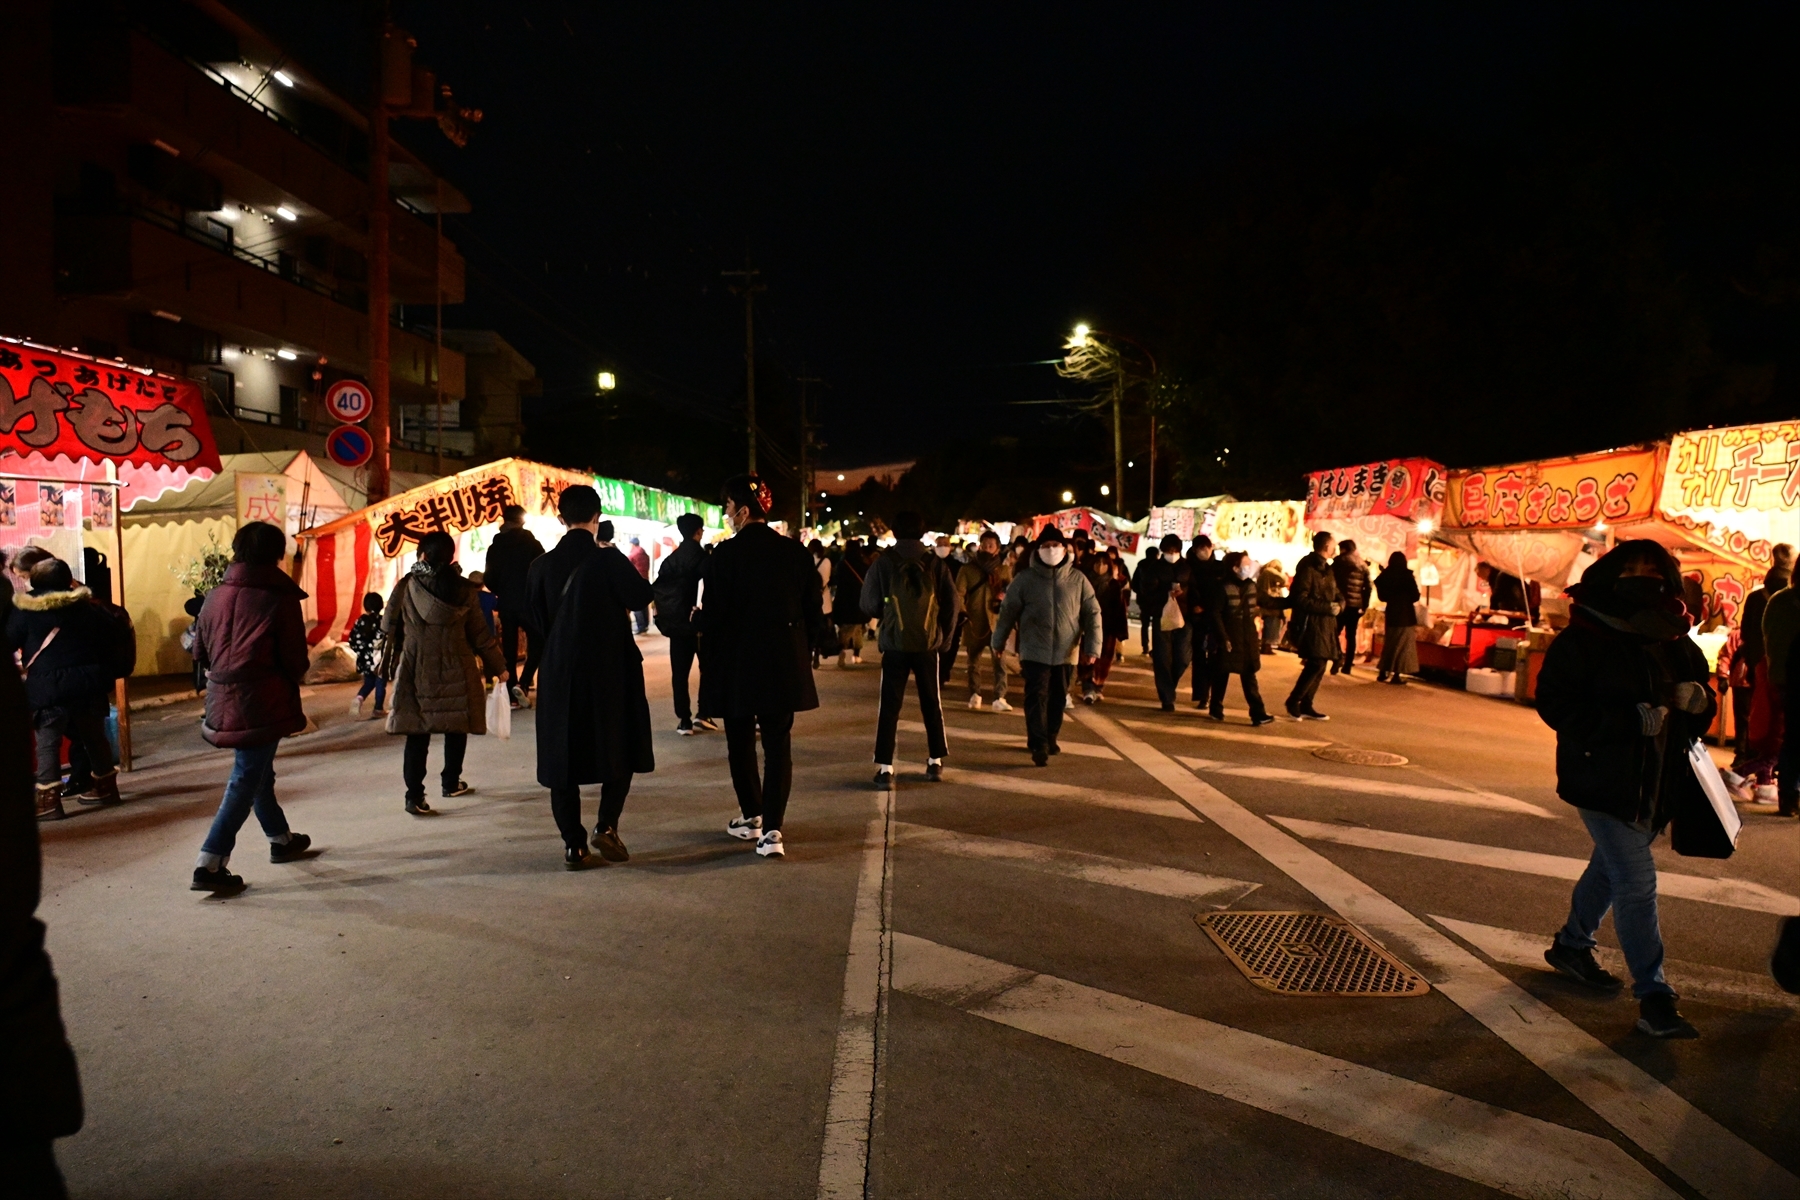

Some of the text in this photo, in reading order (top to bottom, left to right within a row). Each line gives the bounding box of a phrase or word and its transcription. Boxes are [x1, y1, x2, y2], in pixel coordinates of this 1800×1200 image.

[337, 393, 362, 411] 40
[1676, 435, 1719, 474] カリ
[1318, 462, 1388, 498] はしまき
[1460, 471, 1638, 527] 鳥皮ぎょうざ
[1682, 469, 1728, 507] カリ
[376, 474, 517, 558] 大判焼
